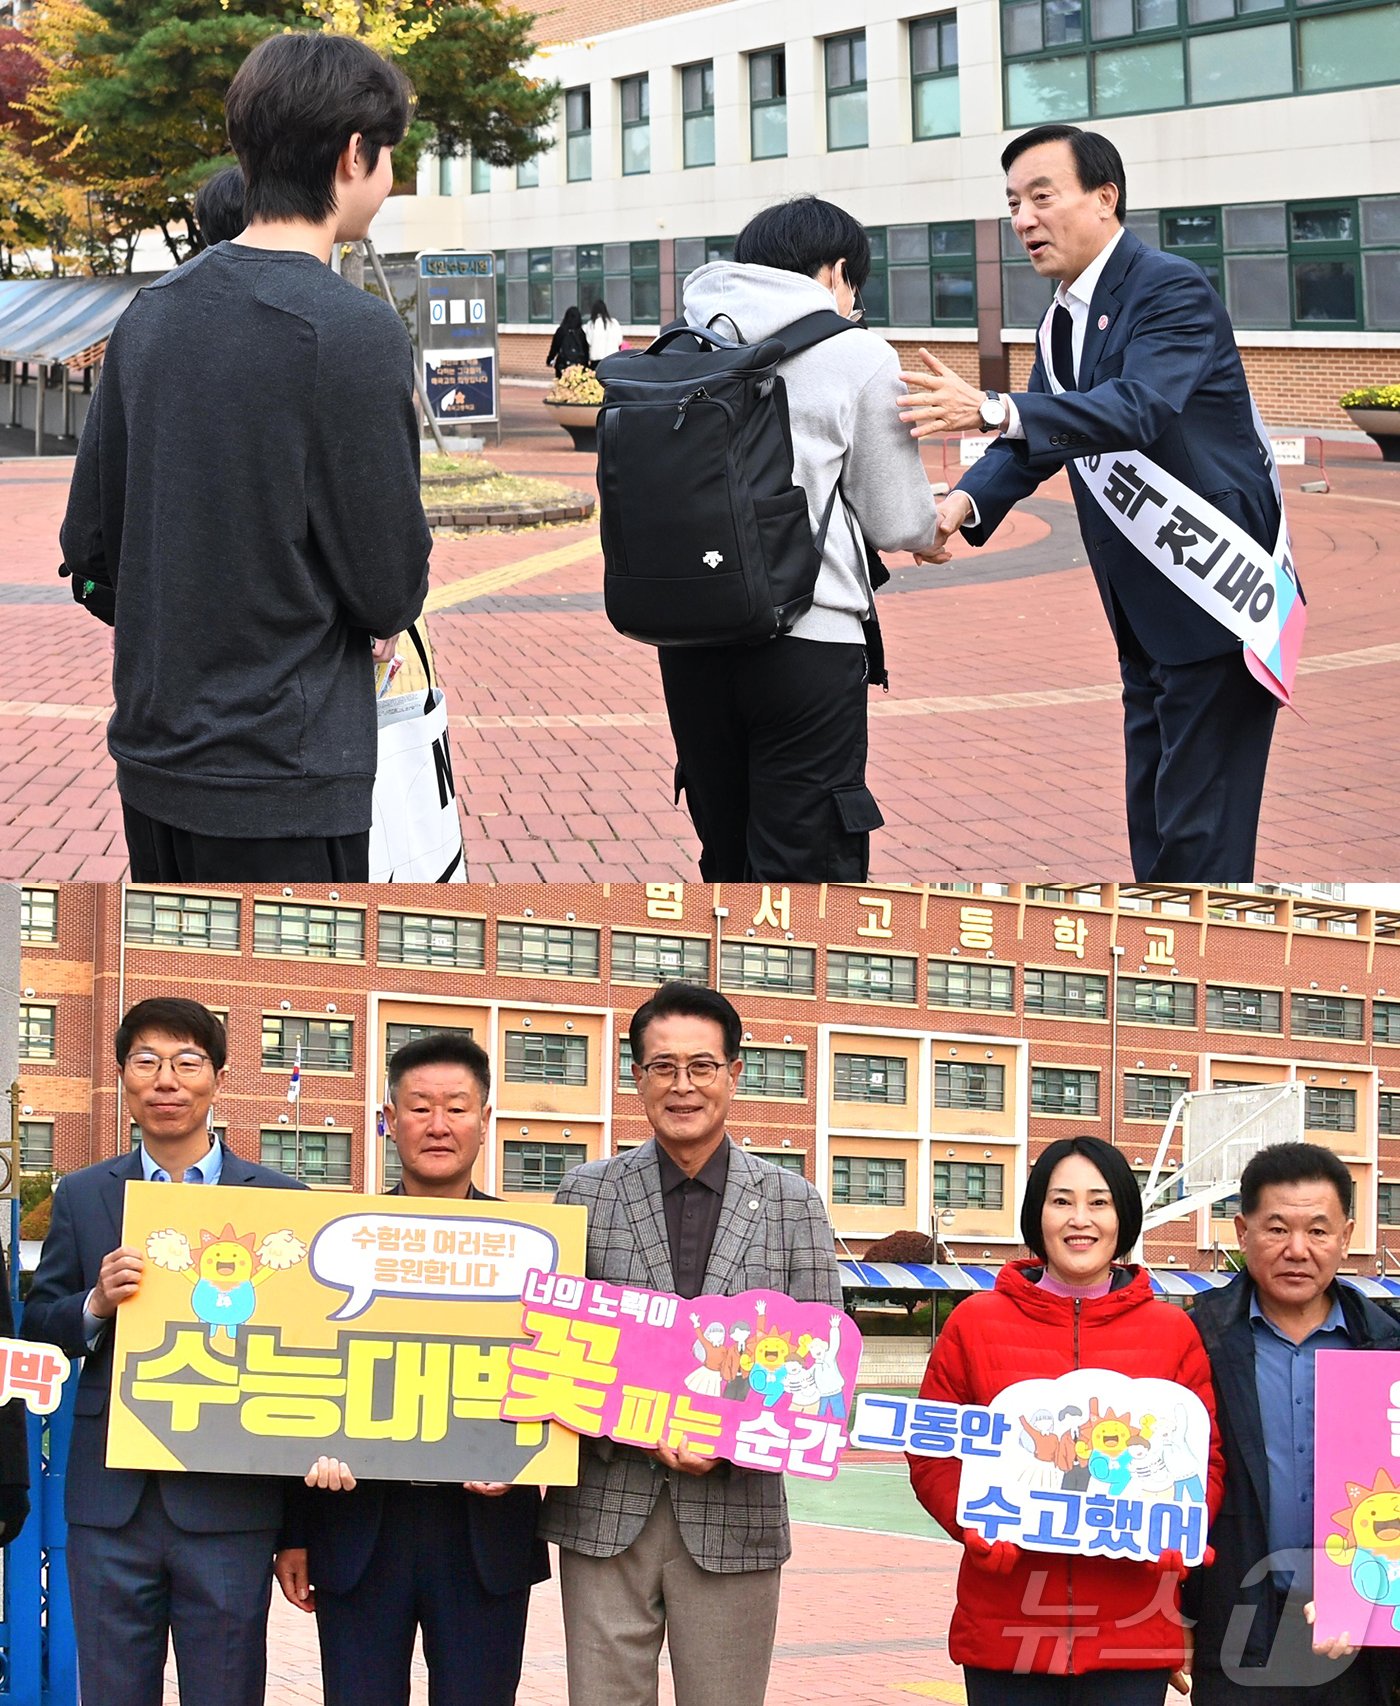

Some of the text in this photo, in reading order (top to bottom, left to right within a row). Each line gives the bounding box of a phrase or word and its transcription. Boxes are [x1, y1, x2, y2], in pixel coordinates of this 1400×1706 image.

[432, 302, 483, 321] 0 0
[1102, 459, 1275, 623] 박천동
[645, 883, 1176, 966] 범서고등학교
[351, 1226, 516, 1258] 수험생 여러분!
[374, 1258, 499, 1288] 응원합니다
[525, 1272, 679, 1329] 너의 노력이
[503, 1311, 849, 1478] 꽃 피는 순간
[858, 1398, 1012, 1457] 그동안
[963, 1485, 1205, 1561] 수고했어
